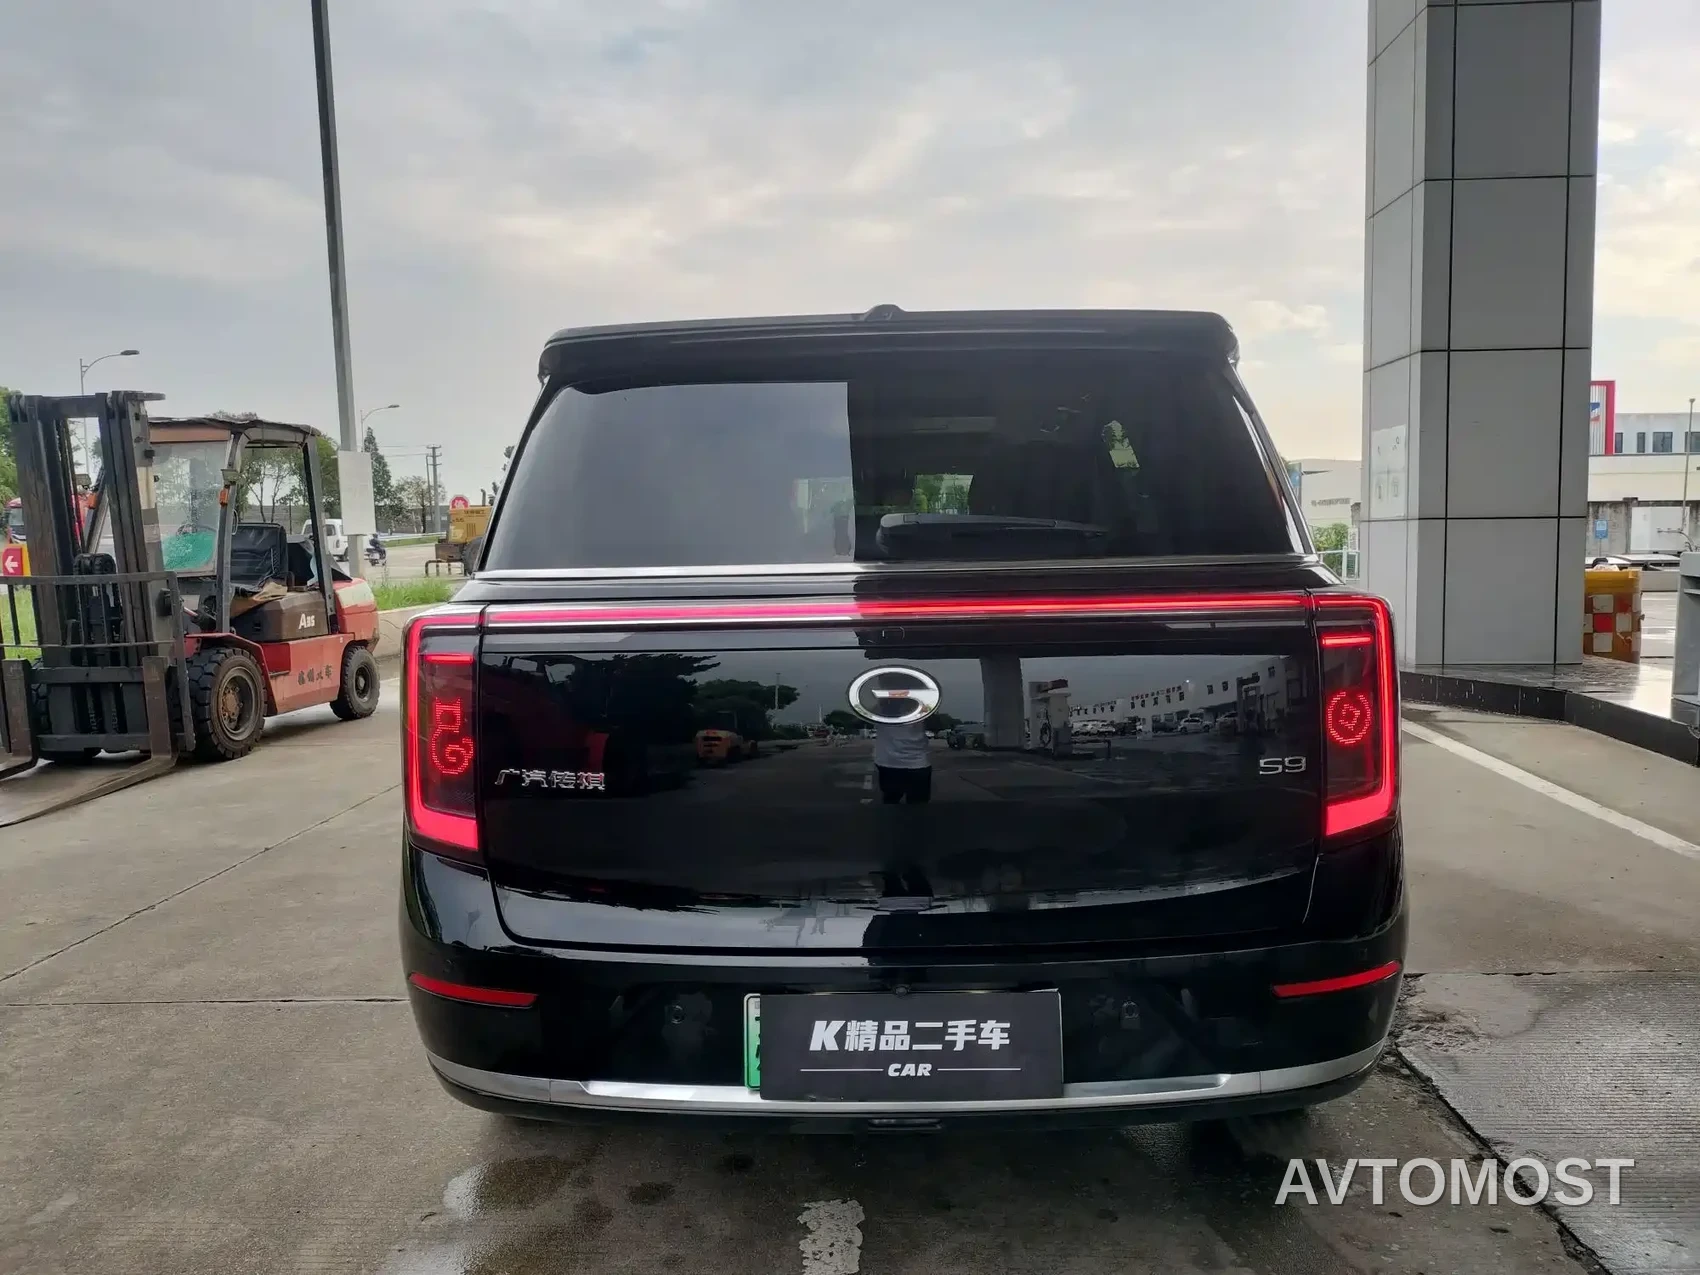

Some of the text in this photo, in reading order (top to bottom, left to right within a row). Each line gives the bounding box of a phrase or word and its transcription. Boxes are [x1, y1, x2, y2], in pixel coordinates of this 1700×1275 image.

[1260, 756, 1306, 774] S9
[494, 768, 605, 790] 广汽传祺
[887, 1063, 932, 1077] CAR
